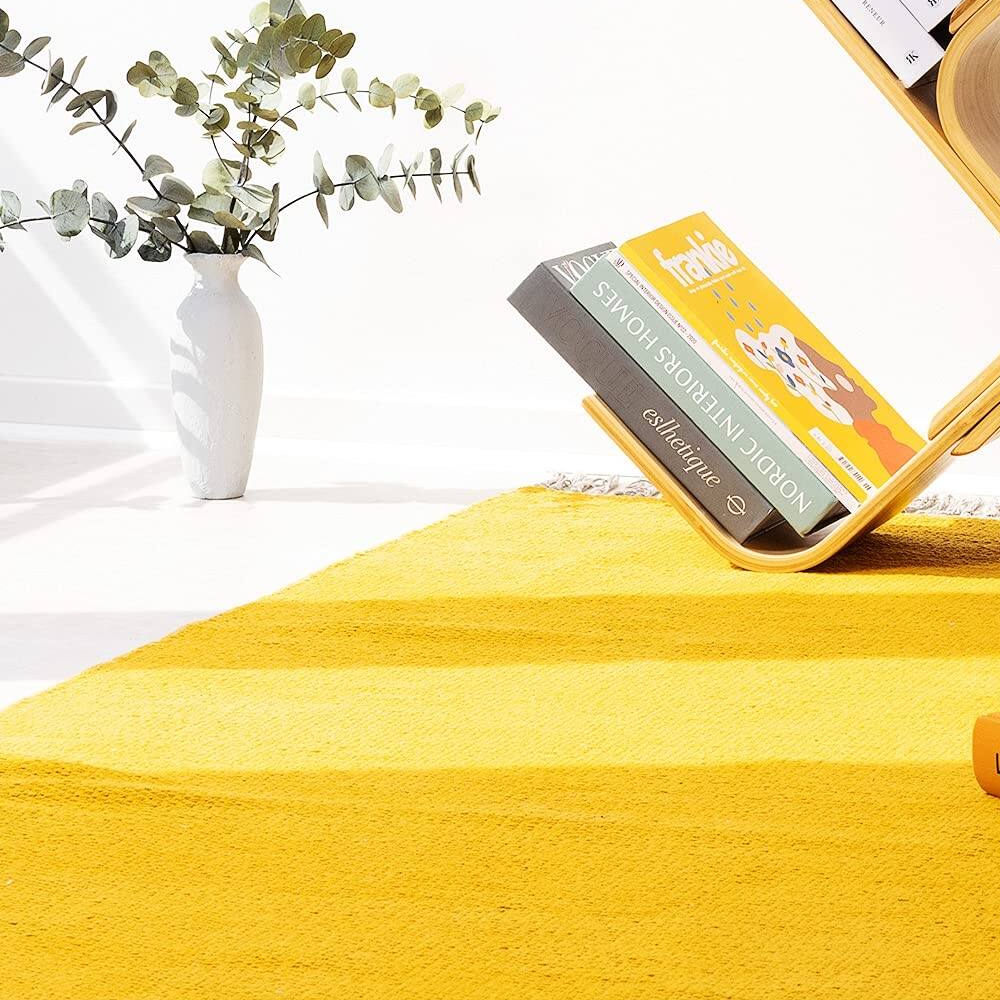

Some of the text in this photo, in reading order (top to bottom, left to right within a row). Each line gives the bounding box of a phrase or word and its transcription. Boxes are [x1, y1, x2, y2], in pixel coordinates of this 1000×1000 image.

[653, 230, 741, 289] frankie
[591, 280, 658, 352] HOMES
[653, 341, 747, 443] INTERIORS
[737, 437, 812, 514] NORDIC
